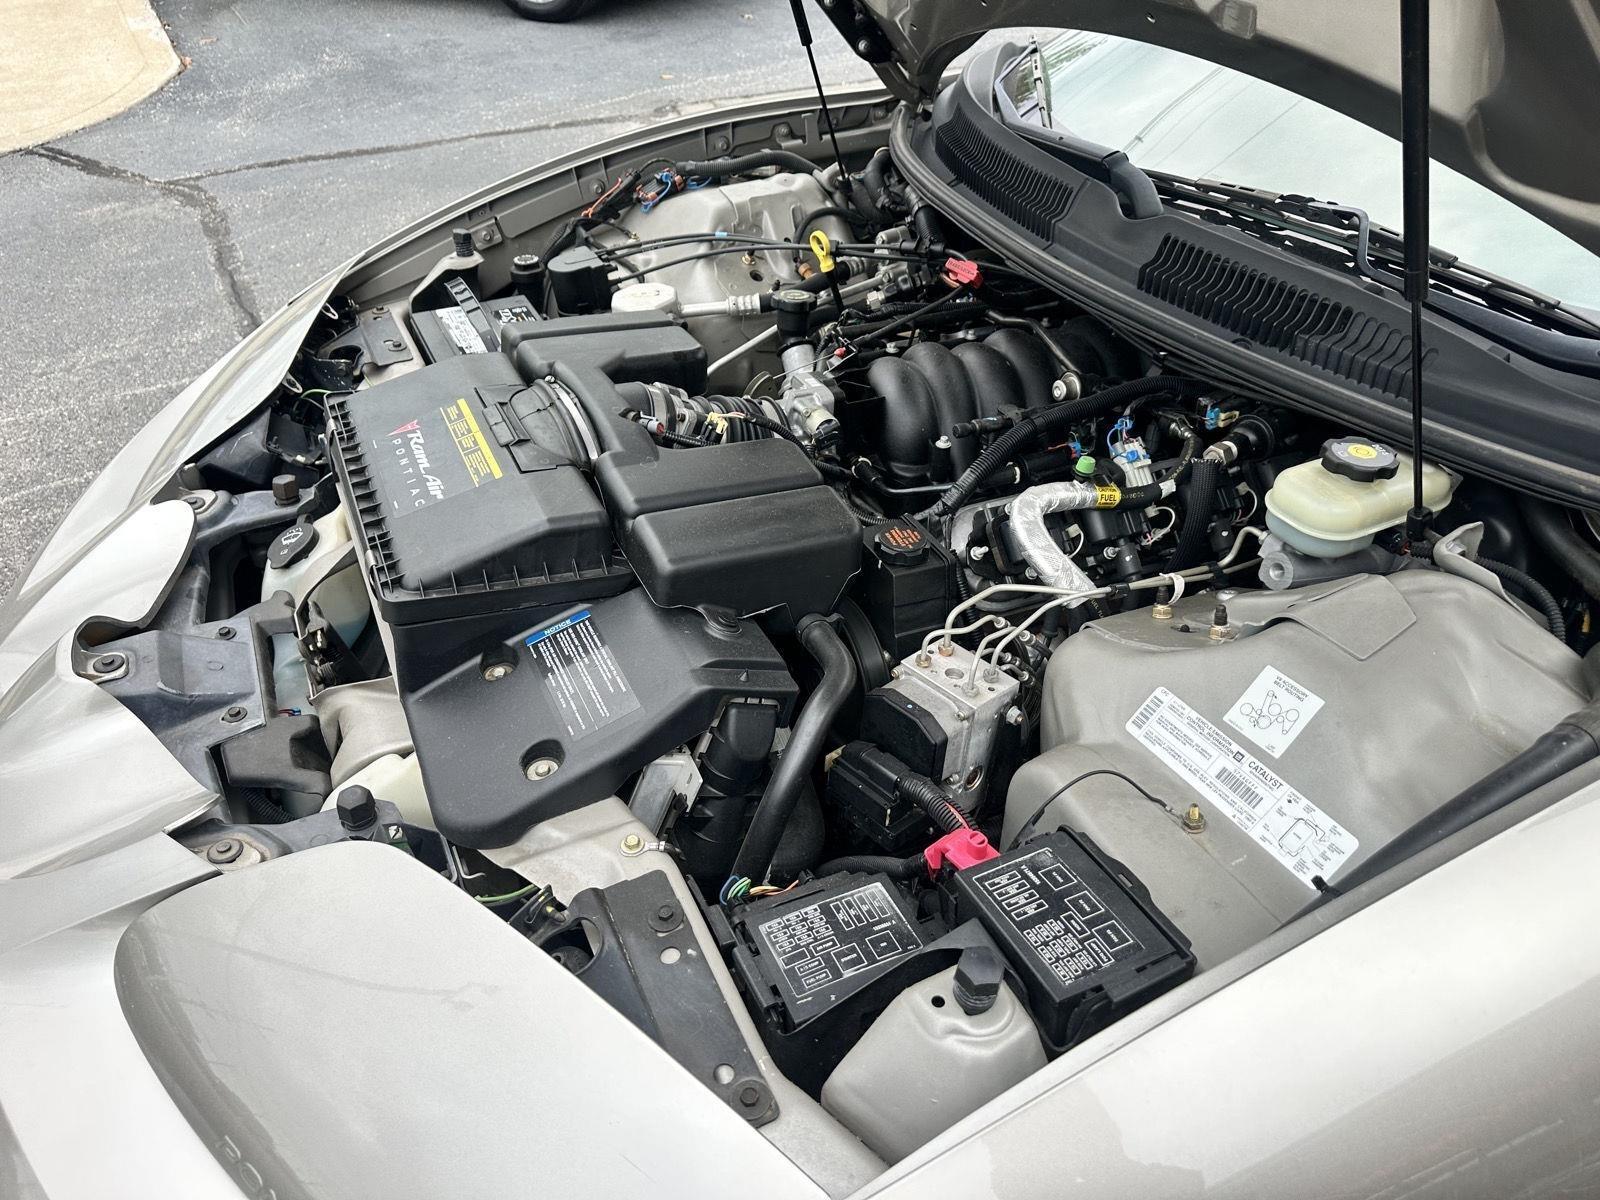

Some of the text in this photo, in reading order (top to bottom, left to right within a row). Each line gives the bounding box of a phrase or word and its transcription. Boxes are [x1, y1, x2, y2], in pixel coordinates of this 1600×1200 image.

[392, 438, 425, 507] PONTIAC
[407, 430, 445, 499] Ram Air
[1100, 494, 1117, 502] FUEL
[545, 619, 571, 635] NOTICE
[1273, 680, 1304, 702] BELT ROUTING
[1281, 679, 1308, 698] ACCESSORY
[1186, 715, 1206, 732] CONTROL
[1205, 731, 1234, 755] INFORMATION
[1194, 716, 1213, 731] VEHICLE
[1212, 729, 1232, 746] EMISSION
[1247, 760, 1283, 790] CATALYST
